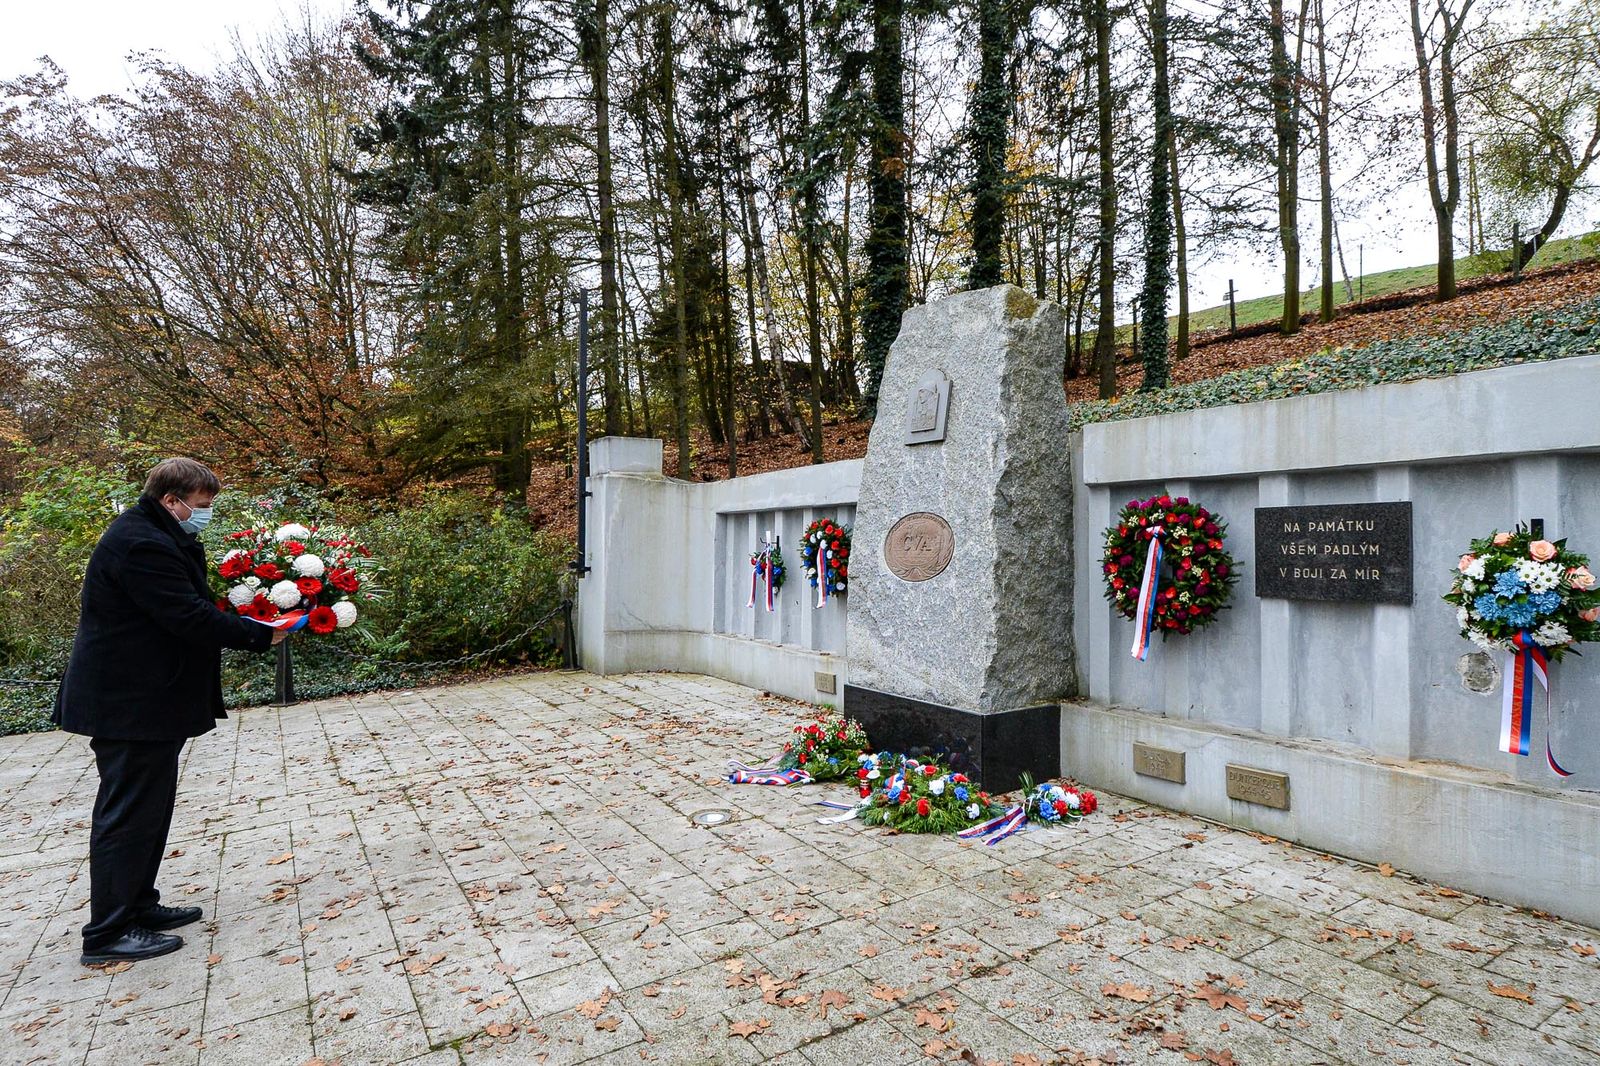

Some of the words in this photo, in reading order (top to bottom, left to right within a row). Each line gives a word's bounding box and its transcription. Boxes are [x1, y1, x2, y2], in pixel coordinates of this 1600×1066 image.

[1284, 522, 1300, 532] NA
[1308, 518, 1374, 532] PAMÁTKU
[1281, 542, 1317, 555] VŠEM
[1324, 541, 1380, 555] PADLÝM
[1279, 567, 1288, 578] V
[1294, 568, 1323, 579] BOJI
[1330, 568, 1347, 579] ZA
[1355, 568, 1380, 580] MÍR
